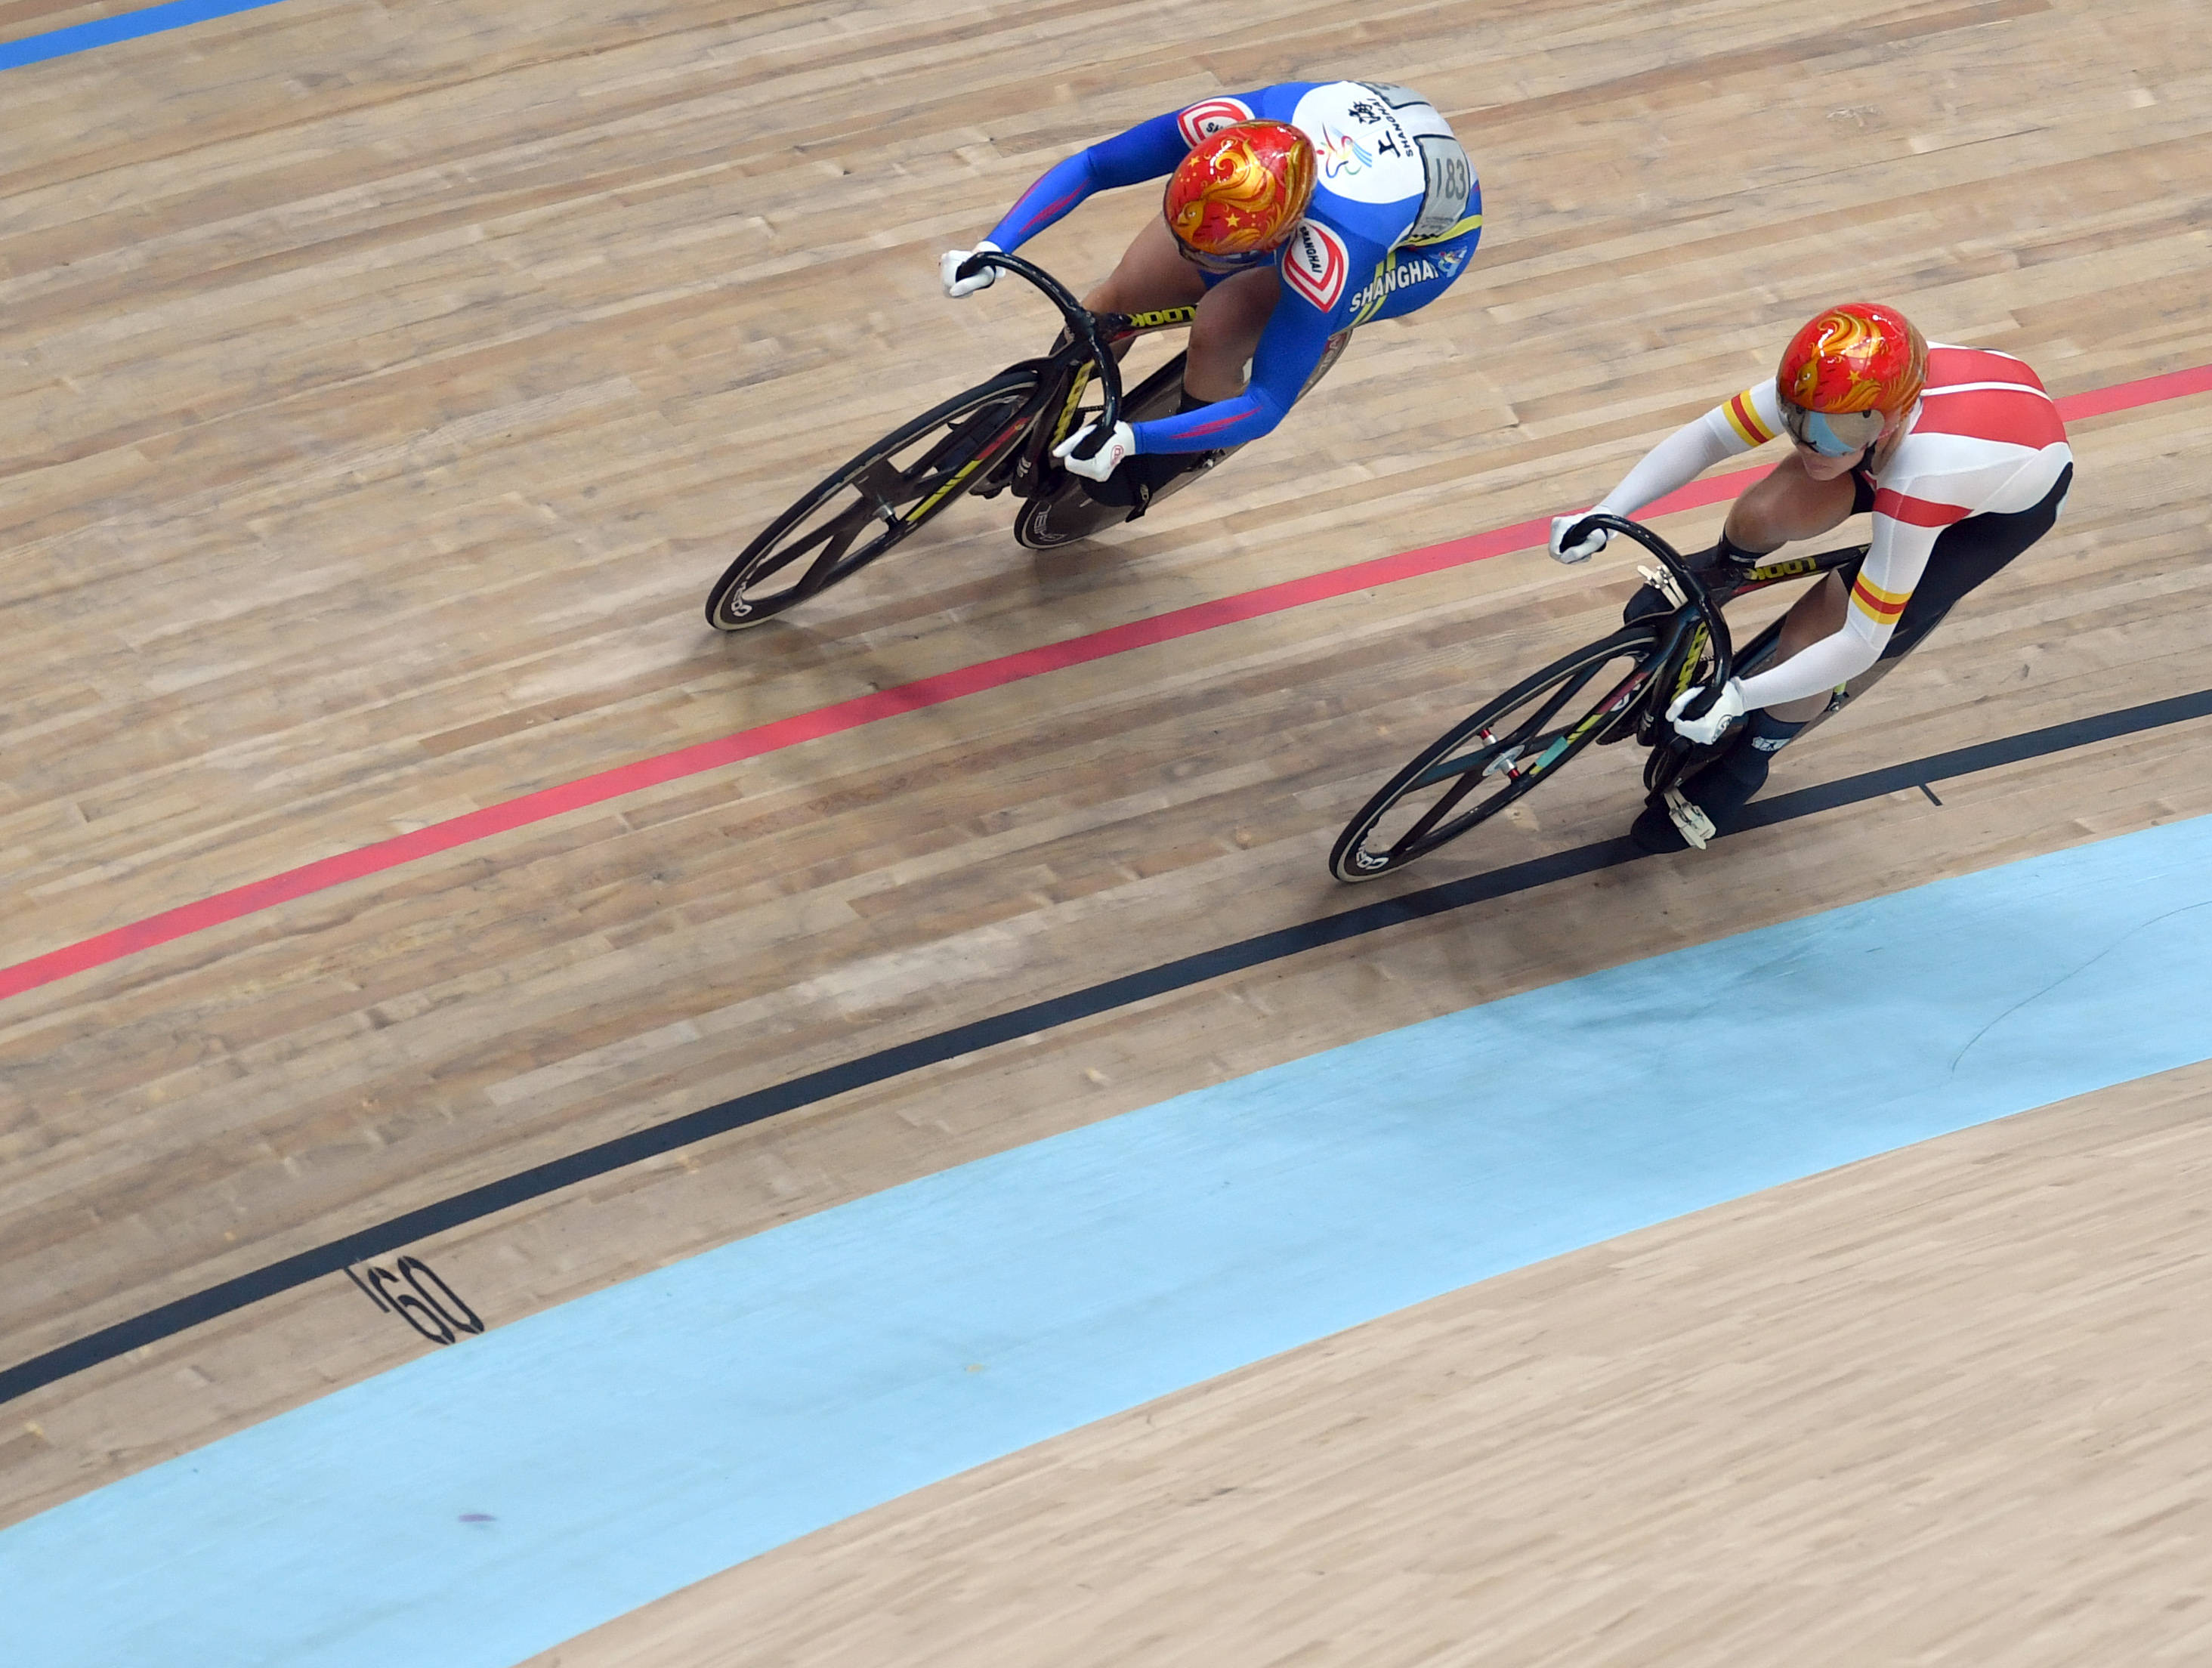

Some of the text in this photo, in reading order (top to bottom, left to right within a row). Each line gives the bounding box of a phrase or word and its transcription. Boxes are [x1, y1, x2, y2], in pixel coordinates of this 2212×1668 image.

[1348, 100, 1401, 158] 上海
[1435, 157, 1466, 200] 183
[1743, 556, 1817, 581] LOOK
